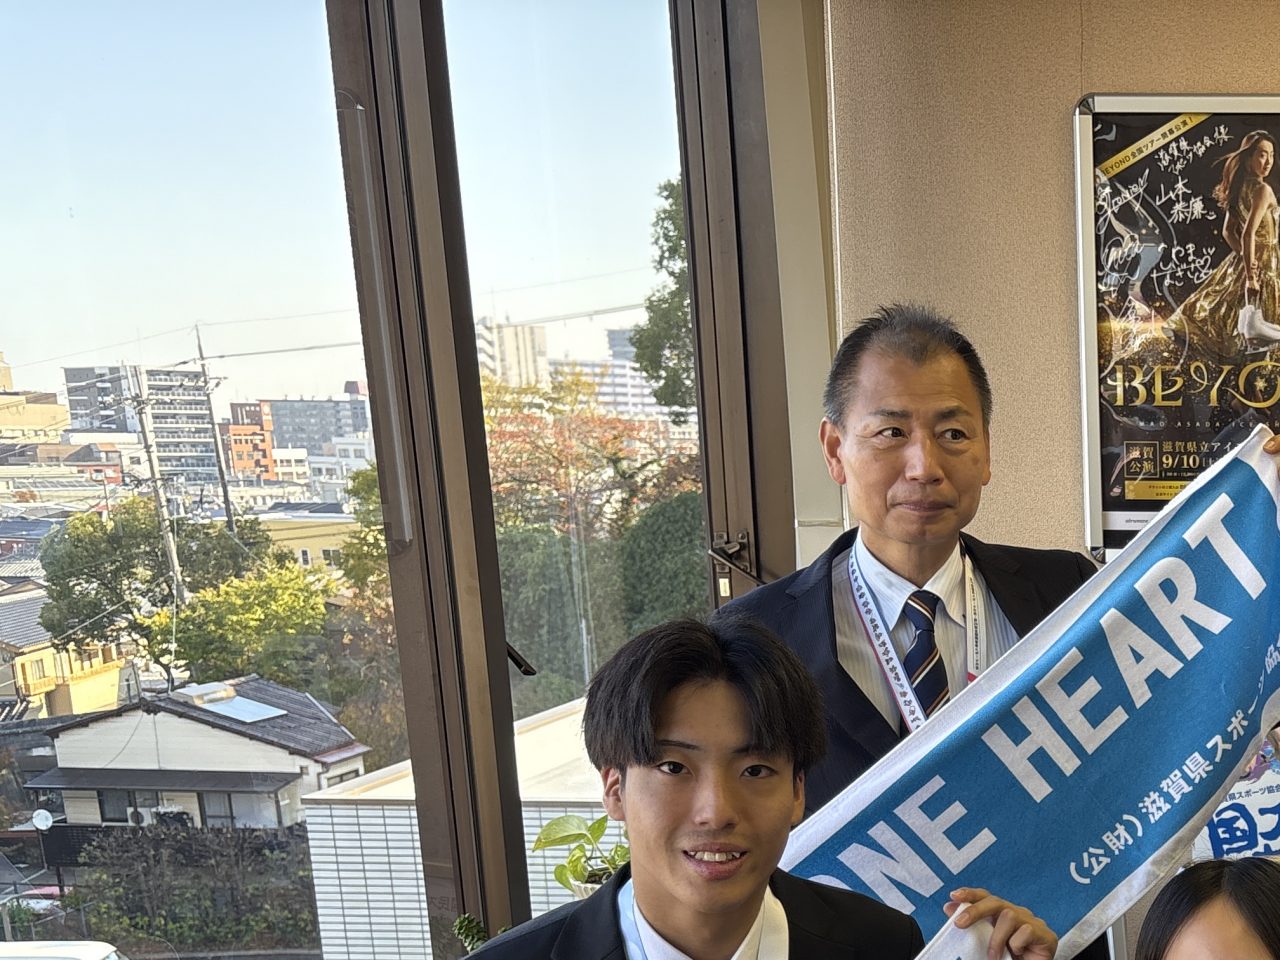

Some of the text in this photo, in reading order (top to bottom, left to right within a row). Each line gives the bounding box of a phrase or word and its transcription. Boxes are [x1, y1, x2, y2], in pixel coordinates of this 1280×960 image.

[1162, 441, 1240, 453] 滋賀県立アイ
[808, 775, 997, 915] NE
[981, 492, 1266, 803] HEART
